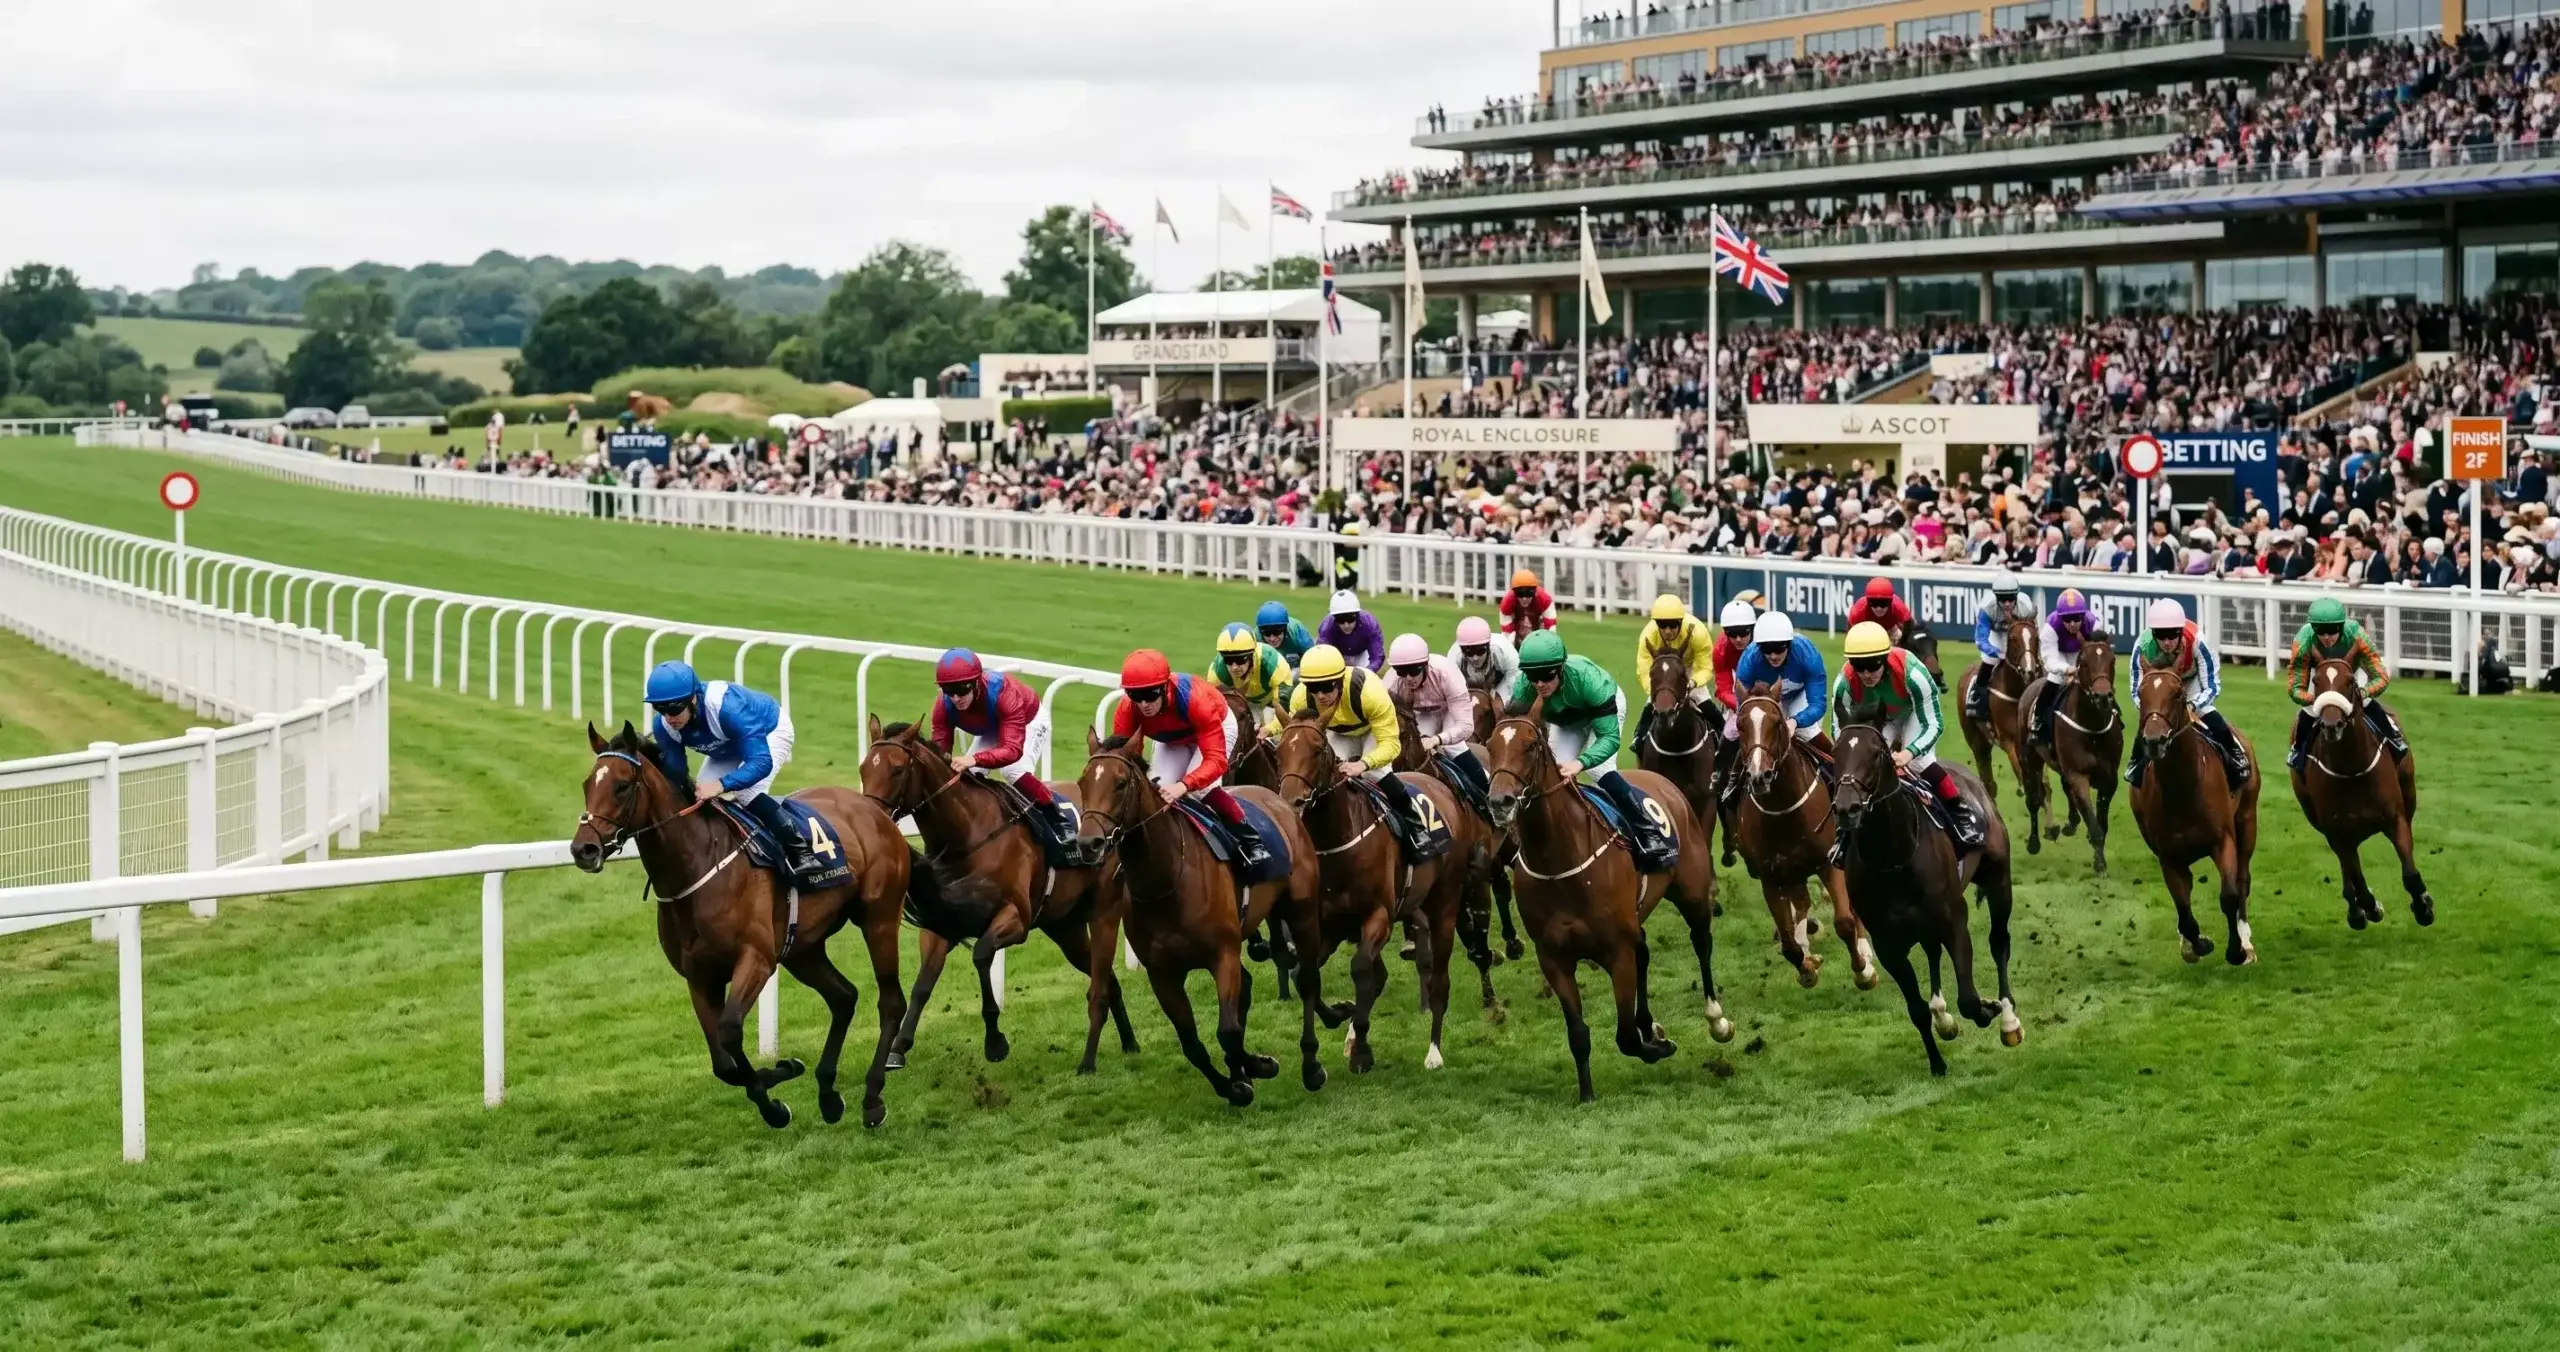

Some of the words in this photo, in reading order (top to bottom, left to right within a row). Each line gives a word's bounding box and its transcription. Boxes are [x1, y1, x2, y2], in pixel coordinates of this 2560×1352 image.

[1132, 343, 1229, 361] GRANDSTAND
[1412, 427, 1476, 443] ROYAL
[1483, 427, 1600, 443] ENCLOSURE
[1869, 417, 1951, 435] ASCOT
[611, 434, 667, 448] BETTING
[2452, 431, 2501, 447] FINISH
[2160, 438, 2267, 463] BETTING
[2465, 451, 2488, 469] 2F
[1785, 576, 1855, 618] BETTING
[1921, 585, 1989, 625] BETTIN
[1642, 797, 1672, 838] 9
[807, 816, 837, 860] 4
